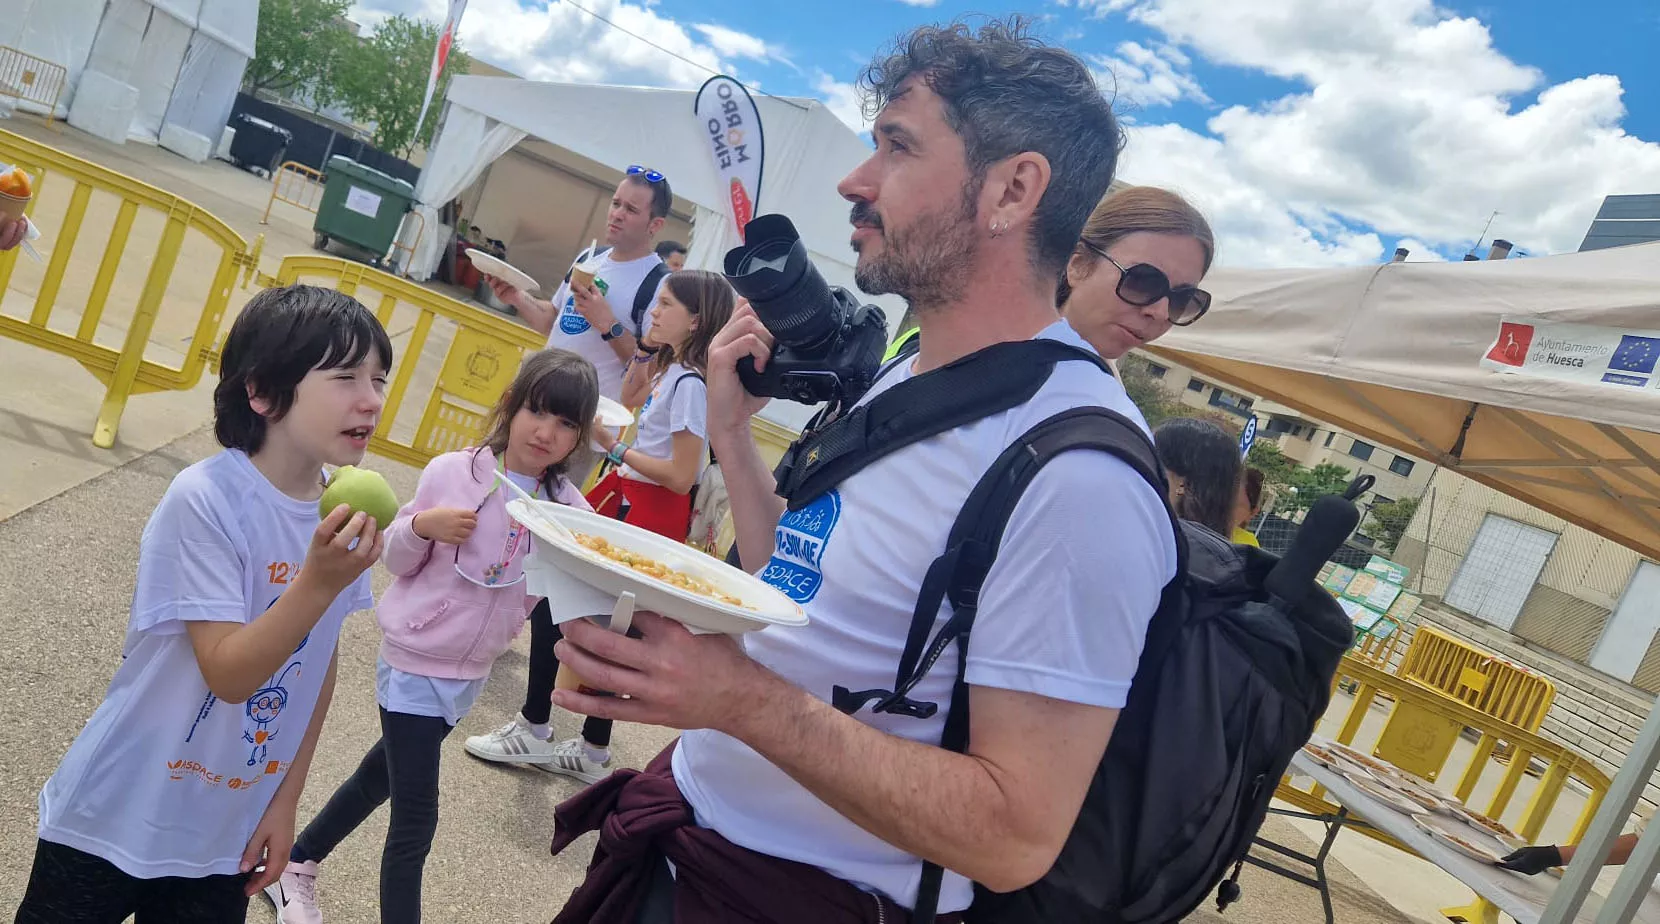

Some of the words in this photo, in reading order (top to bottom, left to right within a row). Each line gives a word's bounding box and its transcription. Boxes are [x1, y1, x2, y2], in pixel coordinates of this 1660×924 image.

[1537, 337, 1608, 355] Ayuntamiento
[1532, 352, 1545, 362] de
[1546, 353, 1584, 368] Huesca
